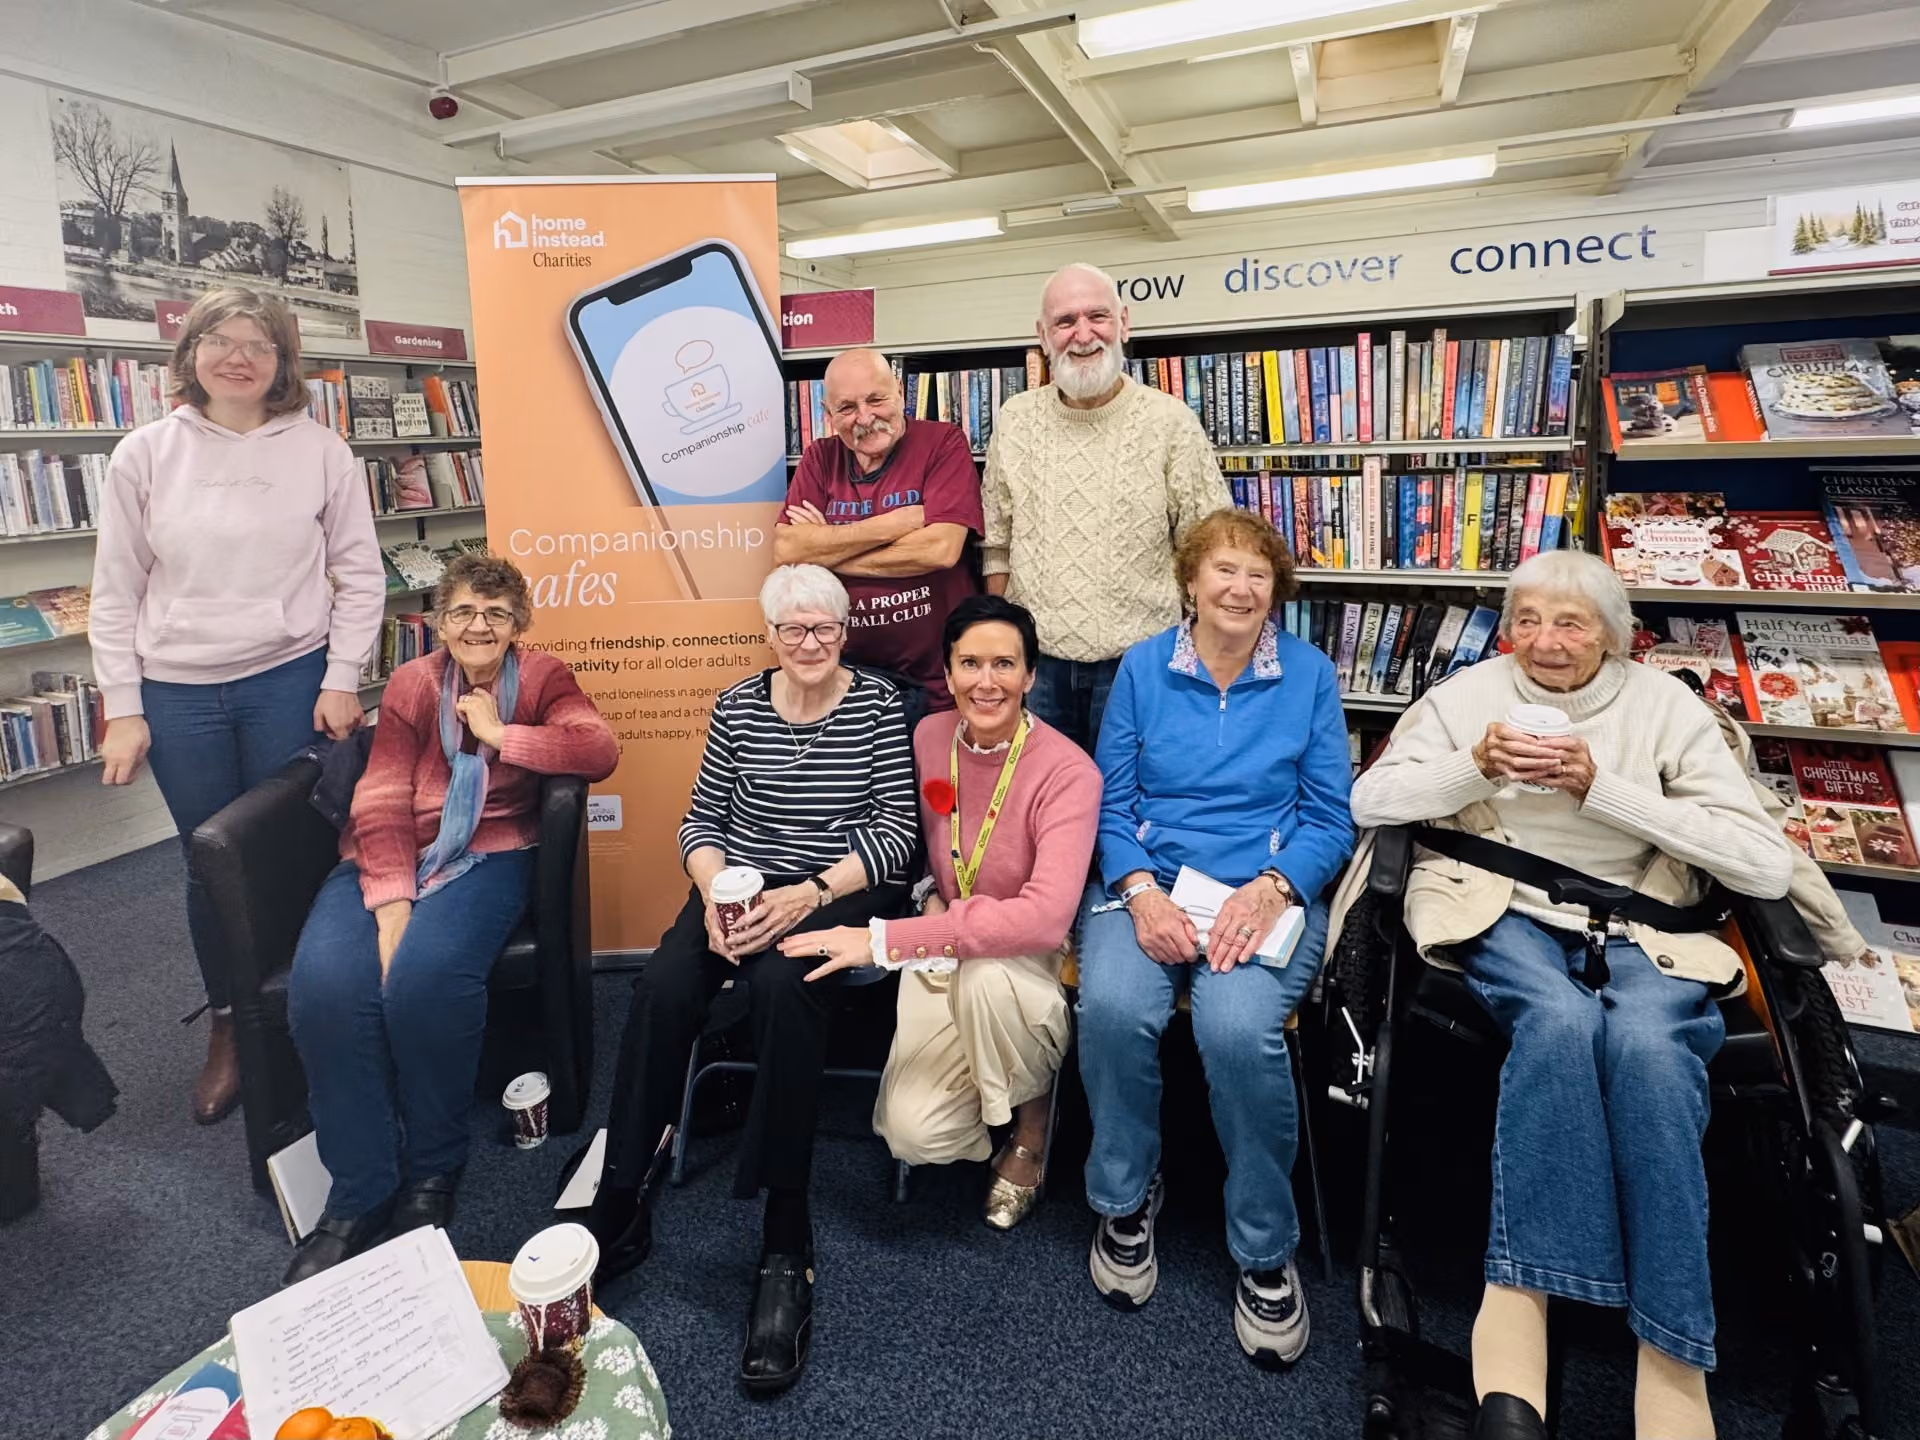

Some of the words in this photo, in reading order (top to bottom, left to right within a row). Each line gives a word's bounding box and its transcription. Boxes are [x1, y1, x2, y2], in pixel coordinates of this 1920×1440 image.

[531, 214, 587, 231] home
[532, 252, 593, 268] Charities
[1225, 252, 1403, 294] discover
[1450, 225, 1657, 275] connect
[782, 311, 814, 327] tion
[394, 335, 443, 350] Gardening
[1766, 361, 1875, 378] CHRISTMAS
[1246, 368, 1254, 400] JEFFERY
[1247, 401, 1255, 431] DEAVER
[661, 422, 746, 464] Companionship
[882, 489, 921, 509] OLD
[1825, 485, 1898, 496] CLASSICS
[1467, 513, 1478, 526] F
[509, 521, 765, 559] Companionship
[855, 599, 867, 611] A
[870, 585, 932, 611] PROPER
[892, 602, 932, 623] CLUB
[1344, 608, 1358, 645] FLYNN
[1364, 607, 1379, 643] FLYNN
[1384, 609, 1400, 645] FLYNN
[1743, 618, 1785, 631] Half
[1788, 620, 1833, 633] Yard
[672, 632, 766, 649] connections
[1772, 630, 1871, 647] Christmas
[623, 656, 645, 671] for
[646, 654, 663, 670] all
[664, 654, 702, 670] older
[706, 653, 752, 668] adults
[594, 689, 618, 701] end
[618, 686, 676, 701] loneliness
[677, 687, 688, 699] in
[601, 710, 623, 722] cup
[624, 708, 638, 720] of
[640, 708, 658, 720] tea
[660, 707, 682, 719] and
[683, 709, 693, 718] a
[618, 726, 654, 741] adults
[1802, 766, 1880, 784] CHRISTMAS
[1824, 780, 1865, 795] GIFTS
